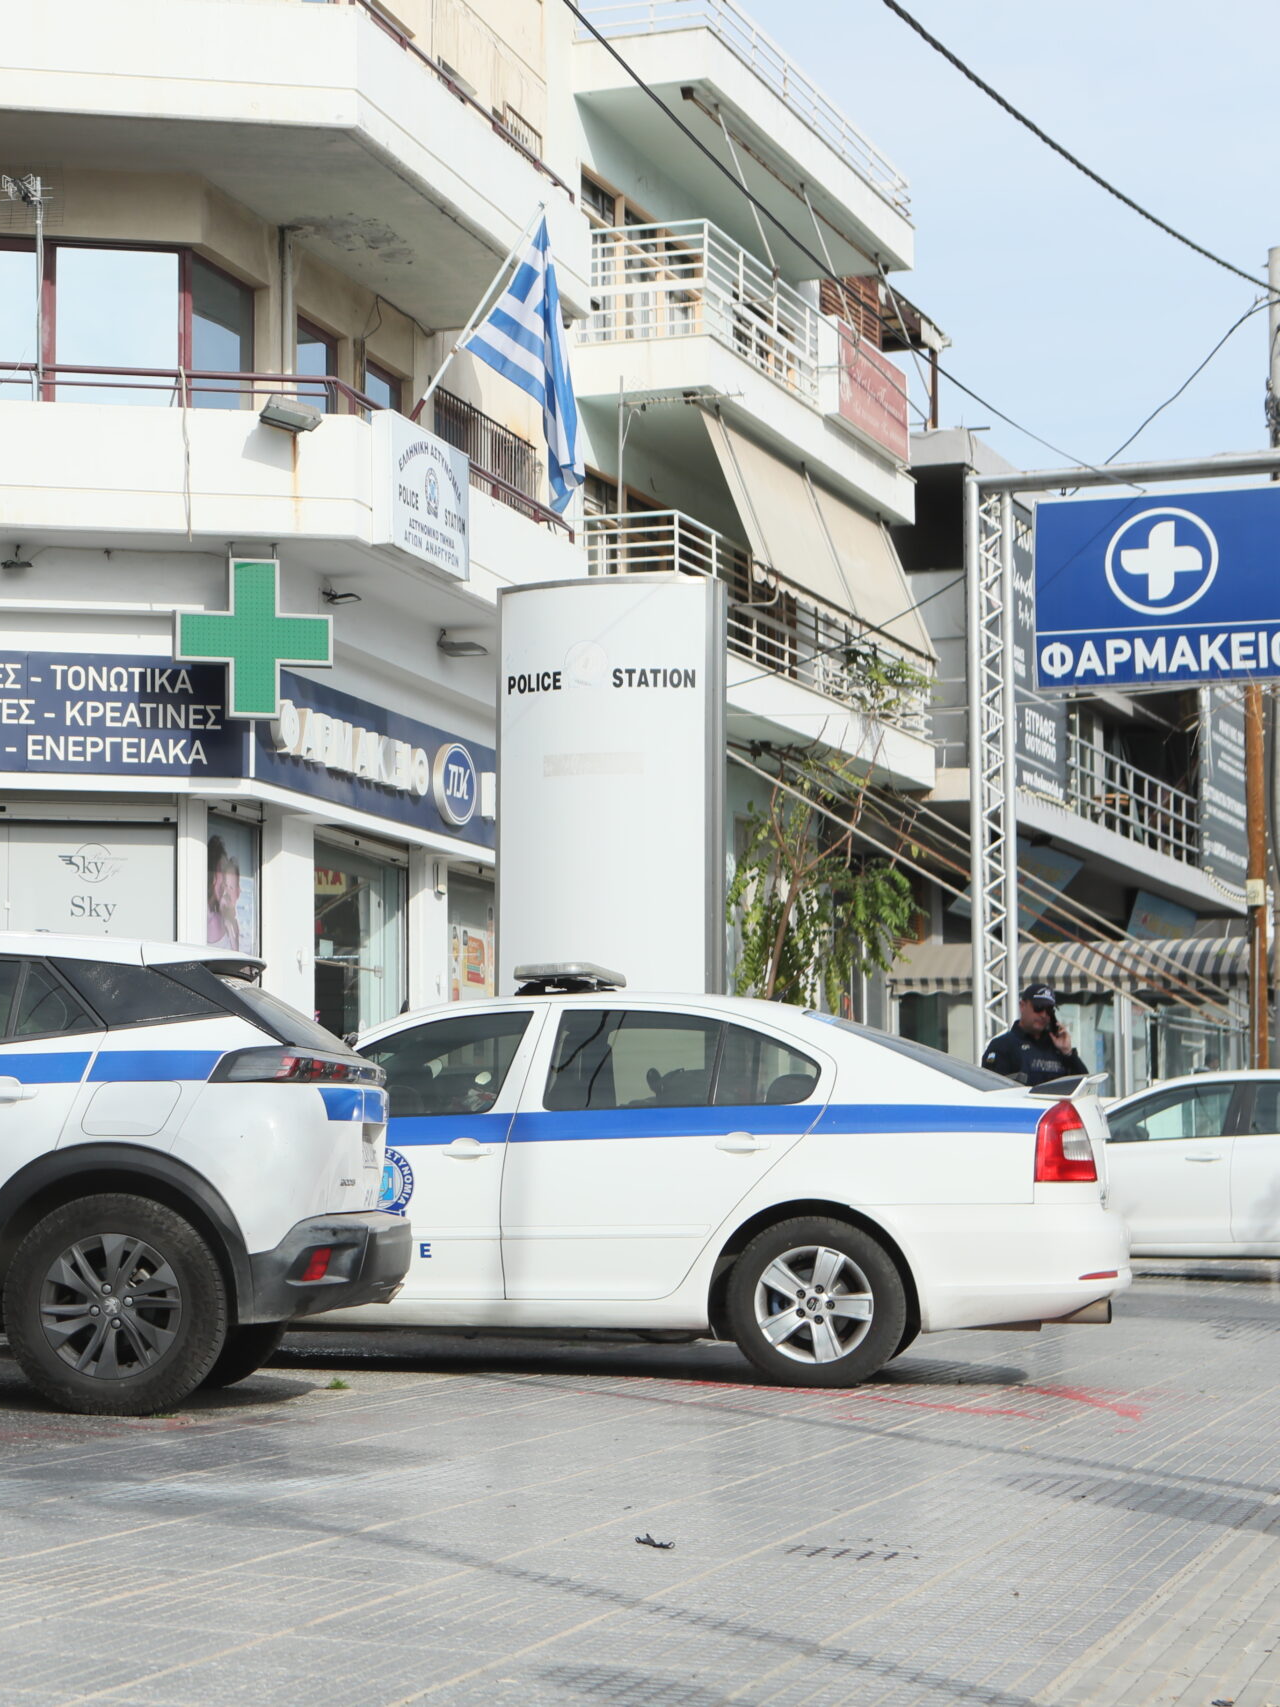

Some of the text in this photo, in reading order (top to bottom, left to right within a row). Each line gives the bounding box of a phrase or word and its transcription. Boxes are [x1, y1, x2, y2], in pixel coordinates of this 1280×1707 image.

[398, 441, 428, 472] ΕΛΛΗΝΙΚΗ
[430, 444, 461, 504] ΑΣΤΥΝΟΜΙΑ
[398, 484, 466, 536] POLICE STATION
[408, 517, 439, 541] ΑΣΤΥΝΟΜΙΚΟ
[404, 530, 459, 568] ΑΓΙΩΝ ΑΝΑΡΓΥΡΩΝ
[50, 664, 194, 694] ΤΟΝΩΤΙΚΑ
[508, 668, 696, 695] POLICE STATION
[65, 701, 222, 730] ΚΡΕΑΤΙΝΕΣ
[27, 734, 208, 765] ΕΝΕΡΓΕΙΑΚΑ
[58, 855, 104, 879] Sky
[70, 895, 117, 922] Sky
